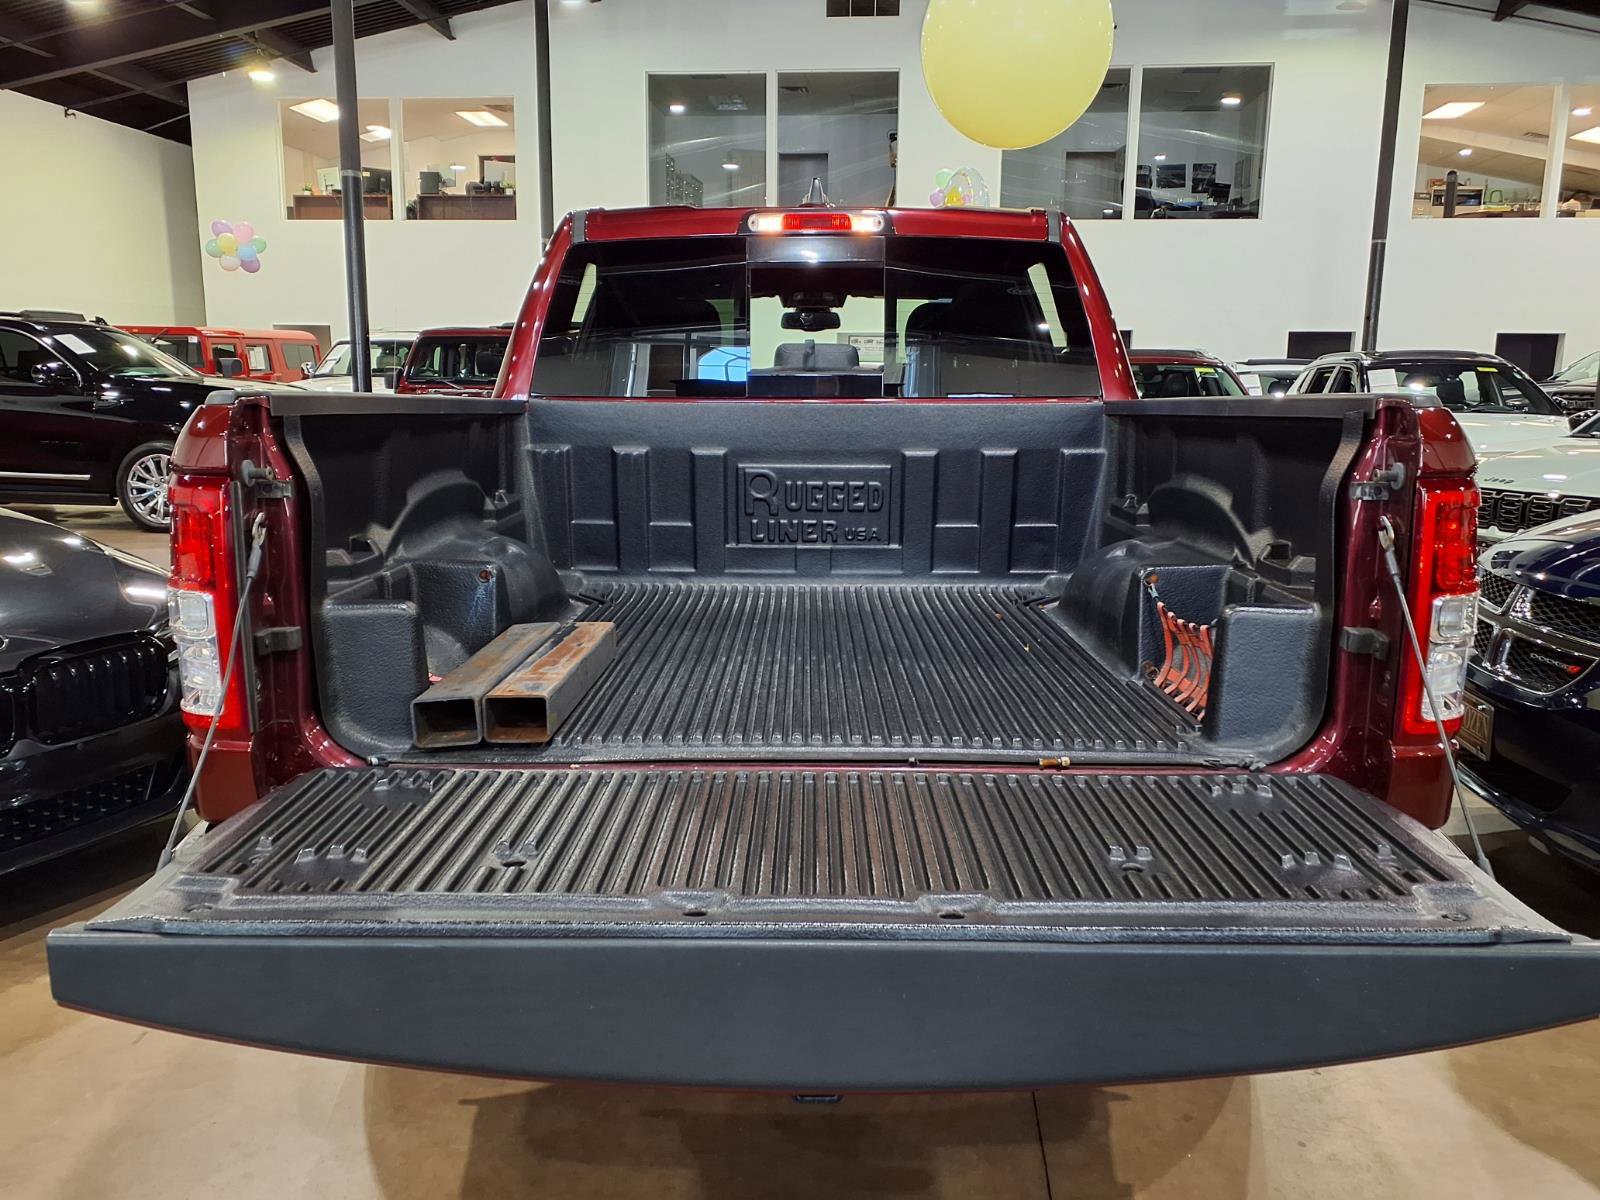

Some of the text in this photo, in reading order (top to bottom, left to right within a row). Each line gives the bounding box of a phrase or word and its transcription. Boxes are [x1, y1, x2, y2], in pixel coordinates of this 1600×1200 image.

[744, 468, 884, 516] RUGGED
[1483, 476, 1514, 485] Jeep
[749, 518, 882, 544] LINER USA
